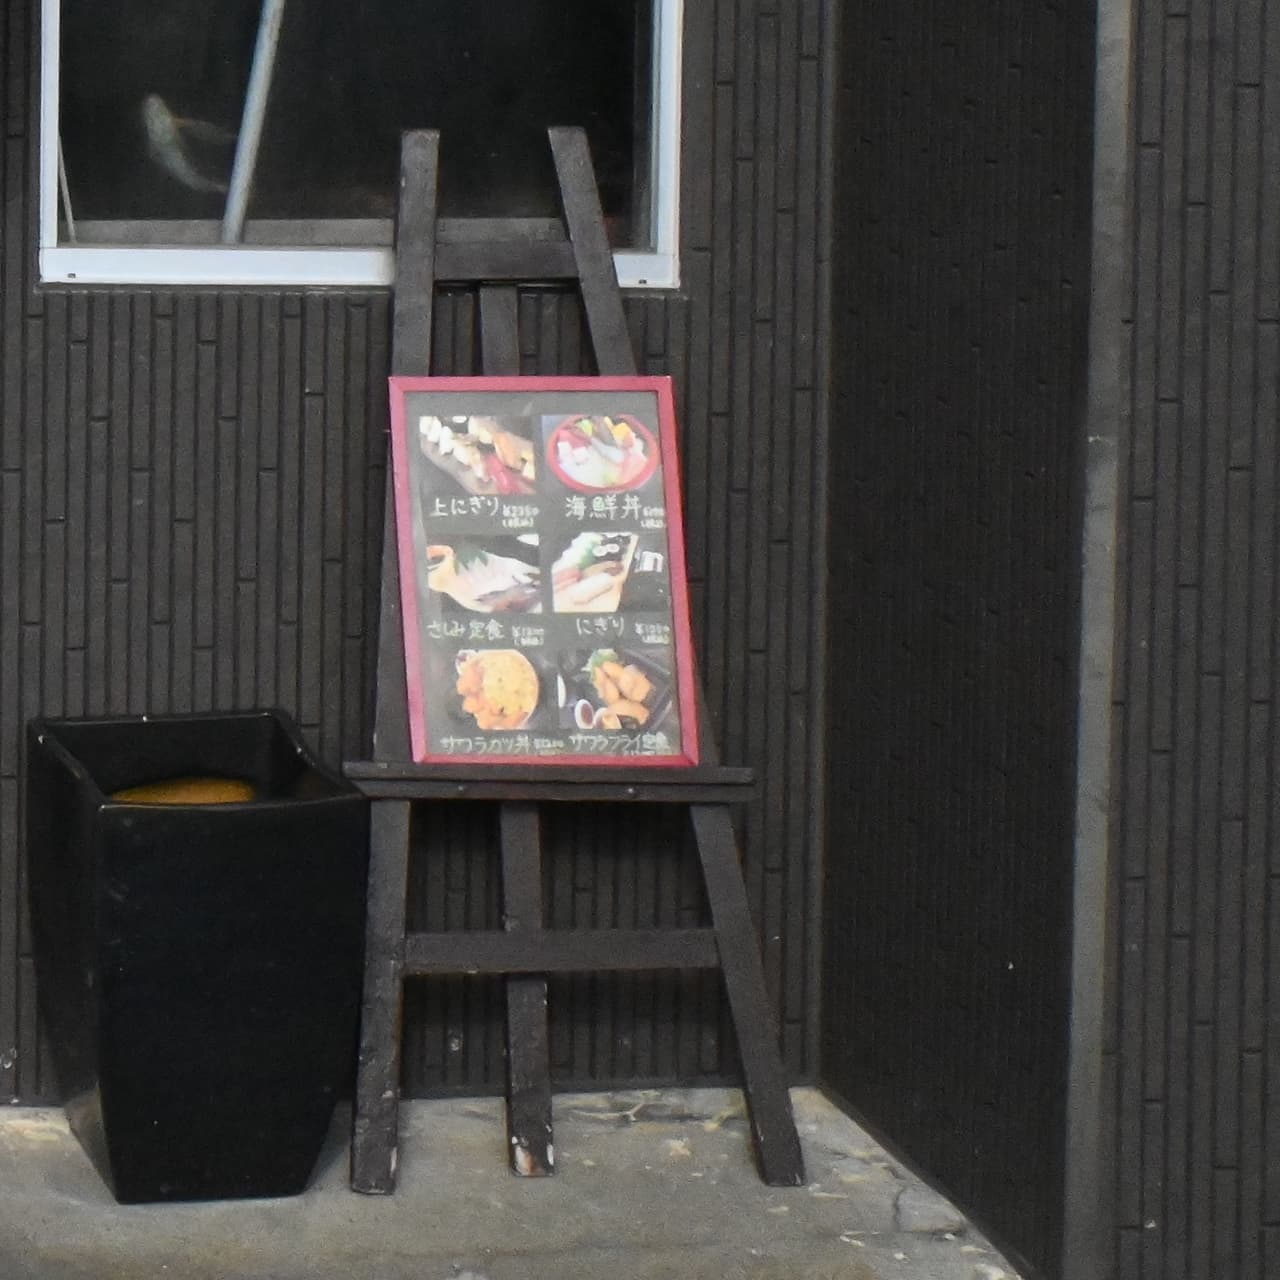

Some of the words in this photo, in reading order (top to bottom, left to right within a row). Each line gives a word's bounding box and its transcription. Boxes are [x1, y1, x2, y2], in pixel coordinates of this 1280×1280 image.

[564, 494, 642, 520] 海鮮丼
[575, 616, 625, 637] にぎり
